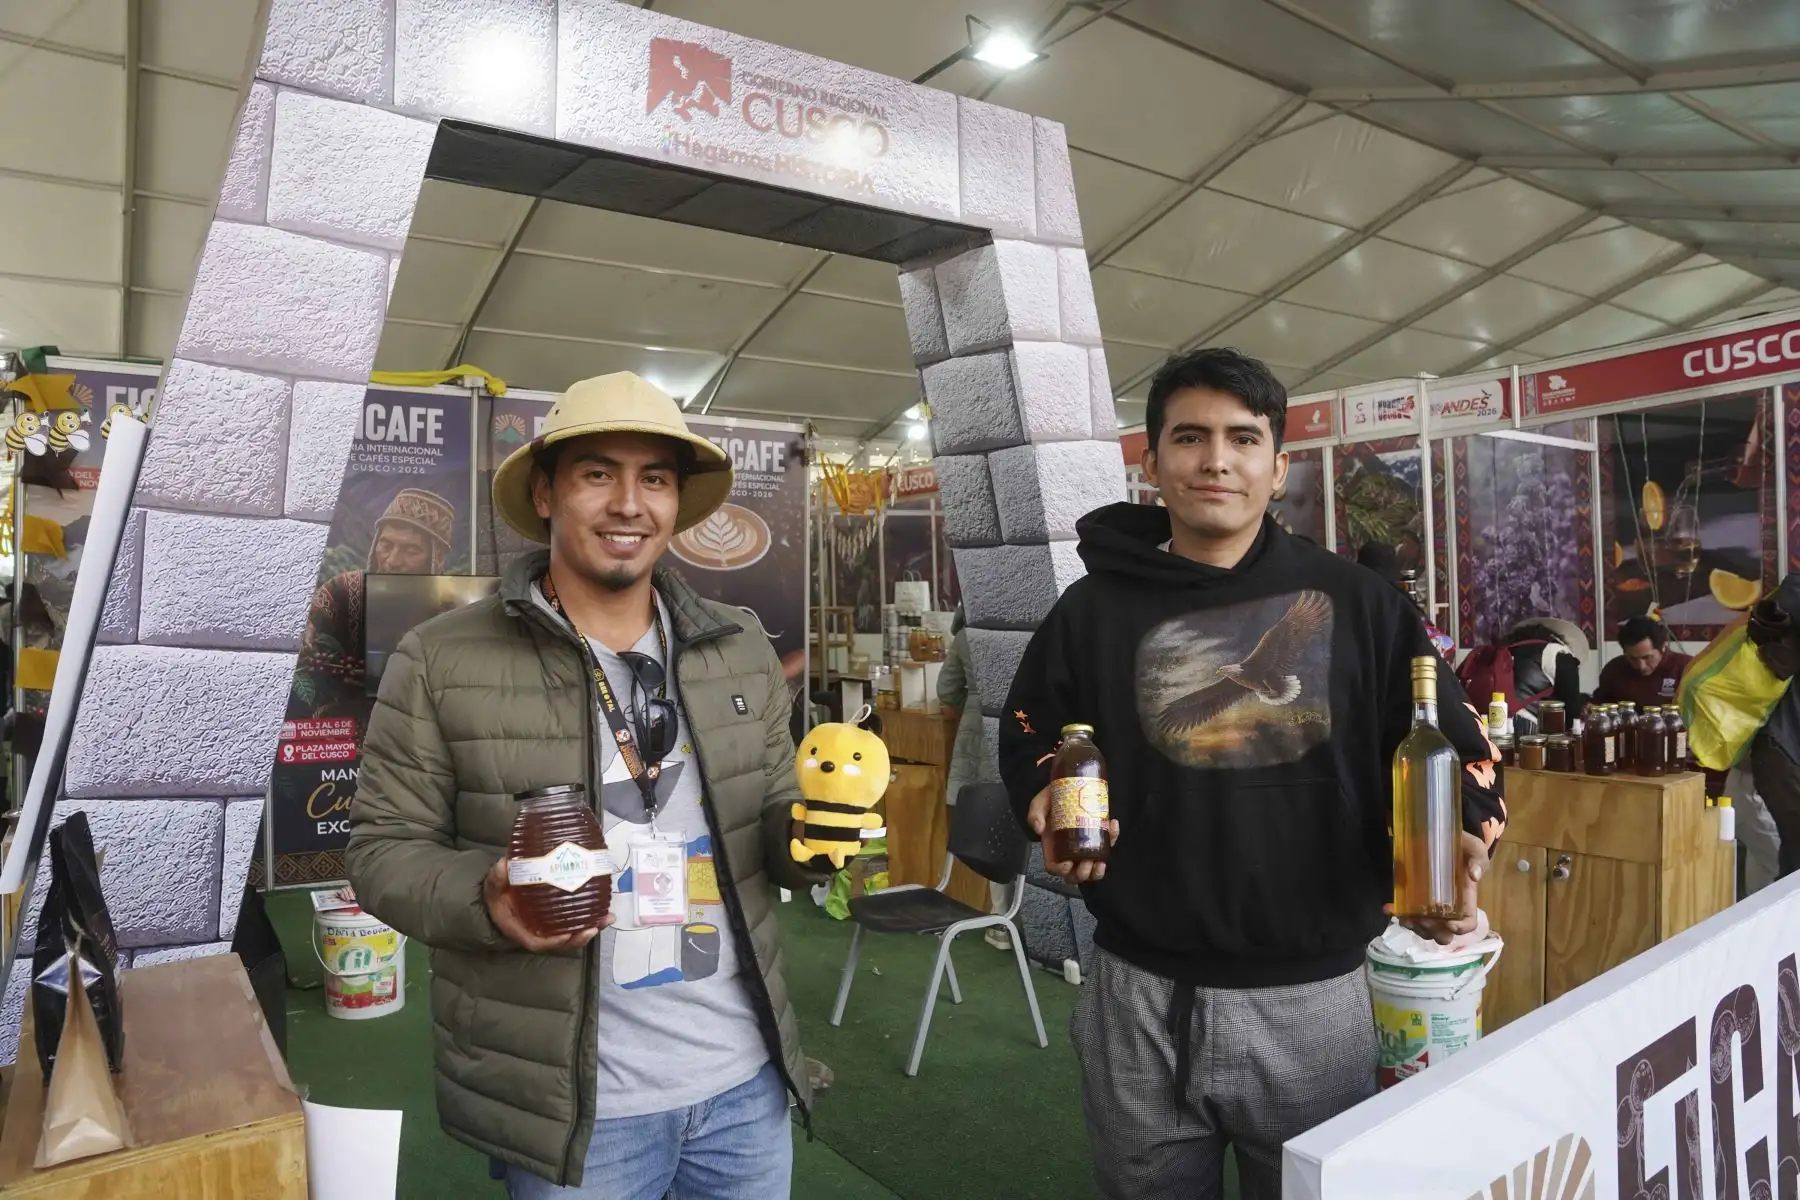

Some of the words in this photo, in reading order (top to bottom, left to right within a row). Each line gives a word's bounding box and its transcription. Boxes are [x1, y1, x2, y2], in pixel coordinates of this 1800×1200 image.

[820, 91, 889, 121] REGIONAL
[366, 443, 444, 457] INTERNACIONAL
[358, 453, 390, 463] CAFÉS
[392, 455, 437, 466] ESPECIAL
[352, 463, 390, 472] CUSCO
[398, 466, 426, 474] 2026
[748, 481, 780, 491] ESPECIAL
[297, 722, 314, 730] DEL
[321, 721, 333, 729] AL
[341, 720, 353, 728] DE
[300, 728, 351, 737] NOVIEMBRE
[295, 744, 325, 753] PLAZA
[325, 742, 355, 752] MAYOR
[301, 752, 319, 760] DEL
[319, 750, 350, 759] CUSCO
[317, 819, 351, 835] EXC
